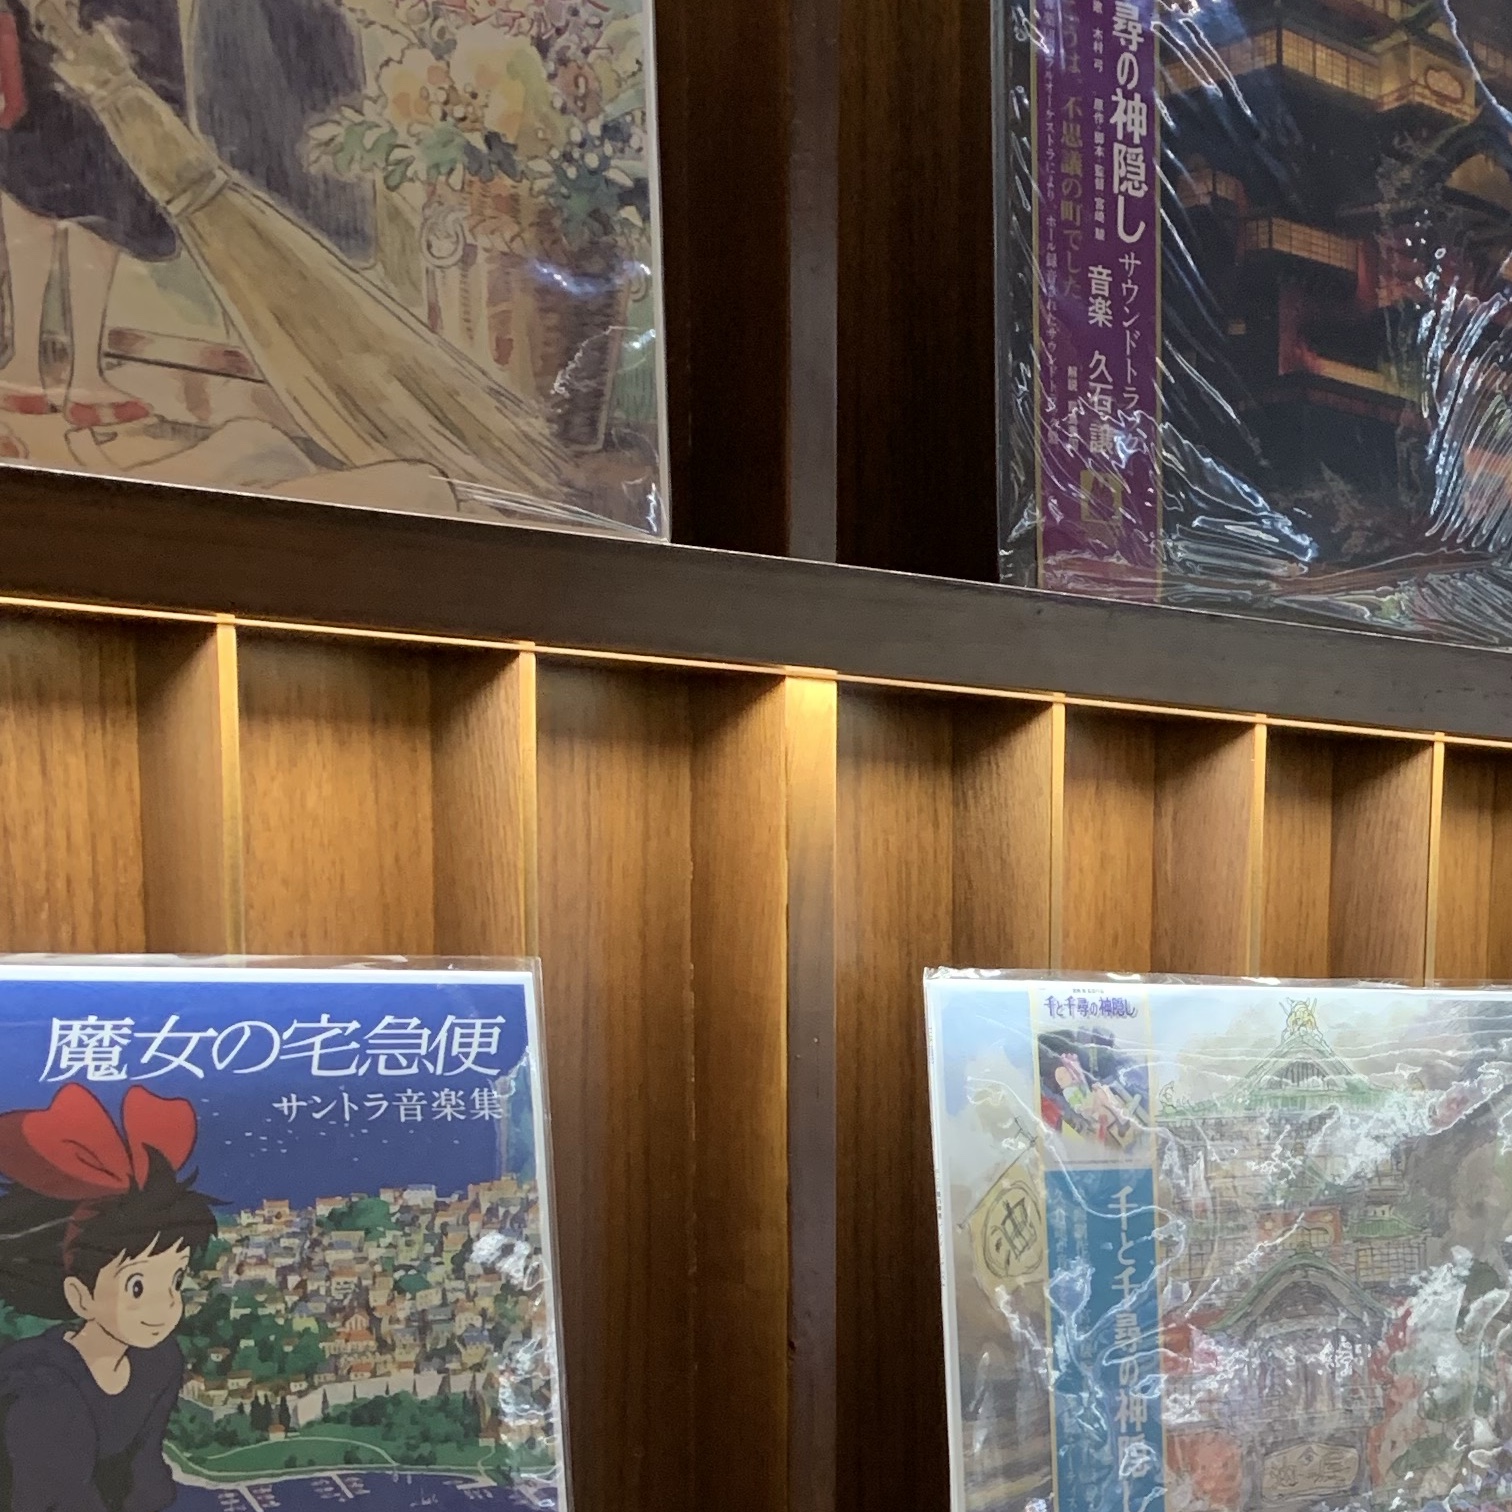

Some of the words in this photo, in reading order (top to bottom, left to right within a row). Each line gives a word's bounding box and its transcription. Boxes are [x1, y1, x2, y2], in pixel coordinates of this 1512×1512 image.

[1087, 265, 1113, 328] 音楽
[1088, 350, 1114, 414] 久石
[39, 1014, 507, 1083] 魔女の宅急便
[271, 1087, 504, 1124] サントラ音楽集
